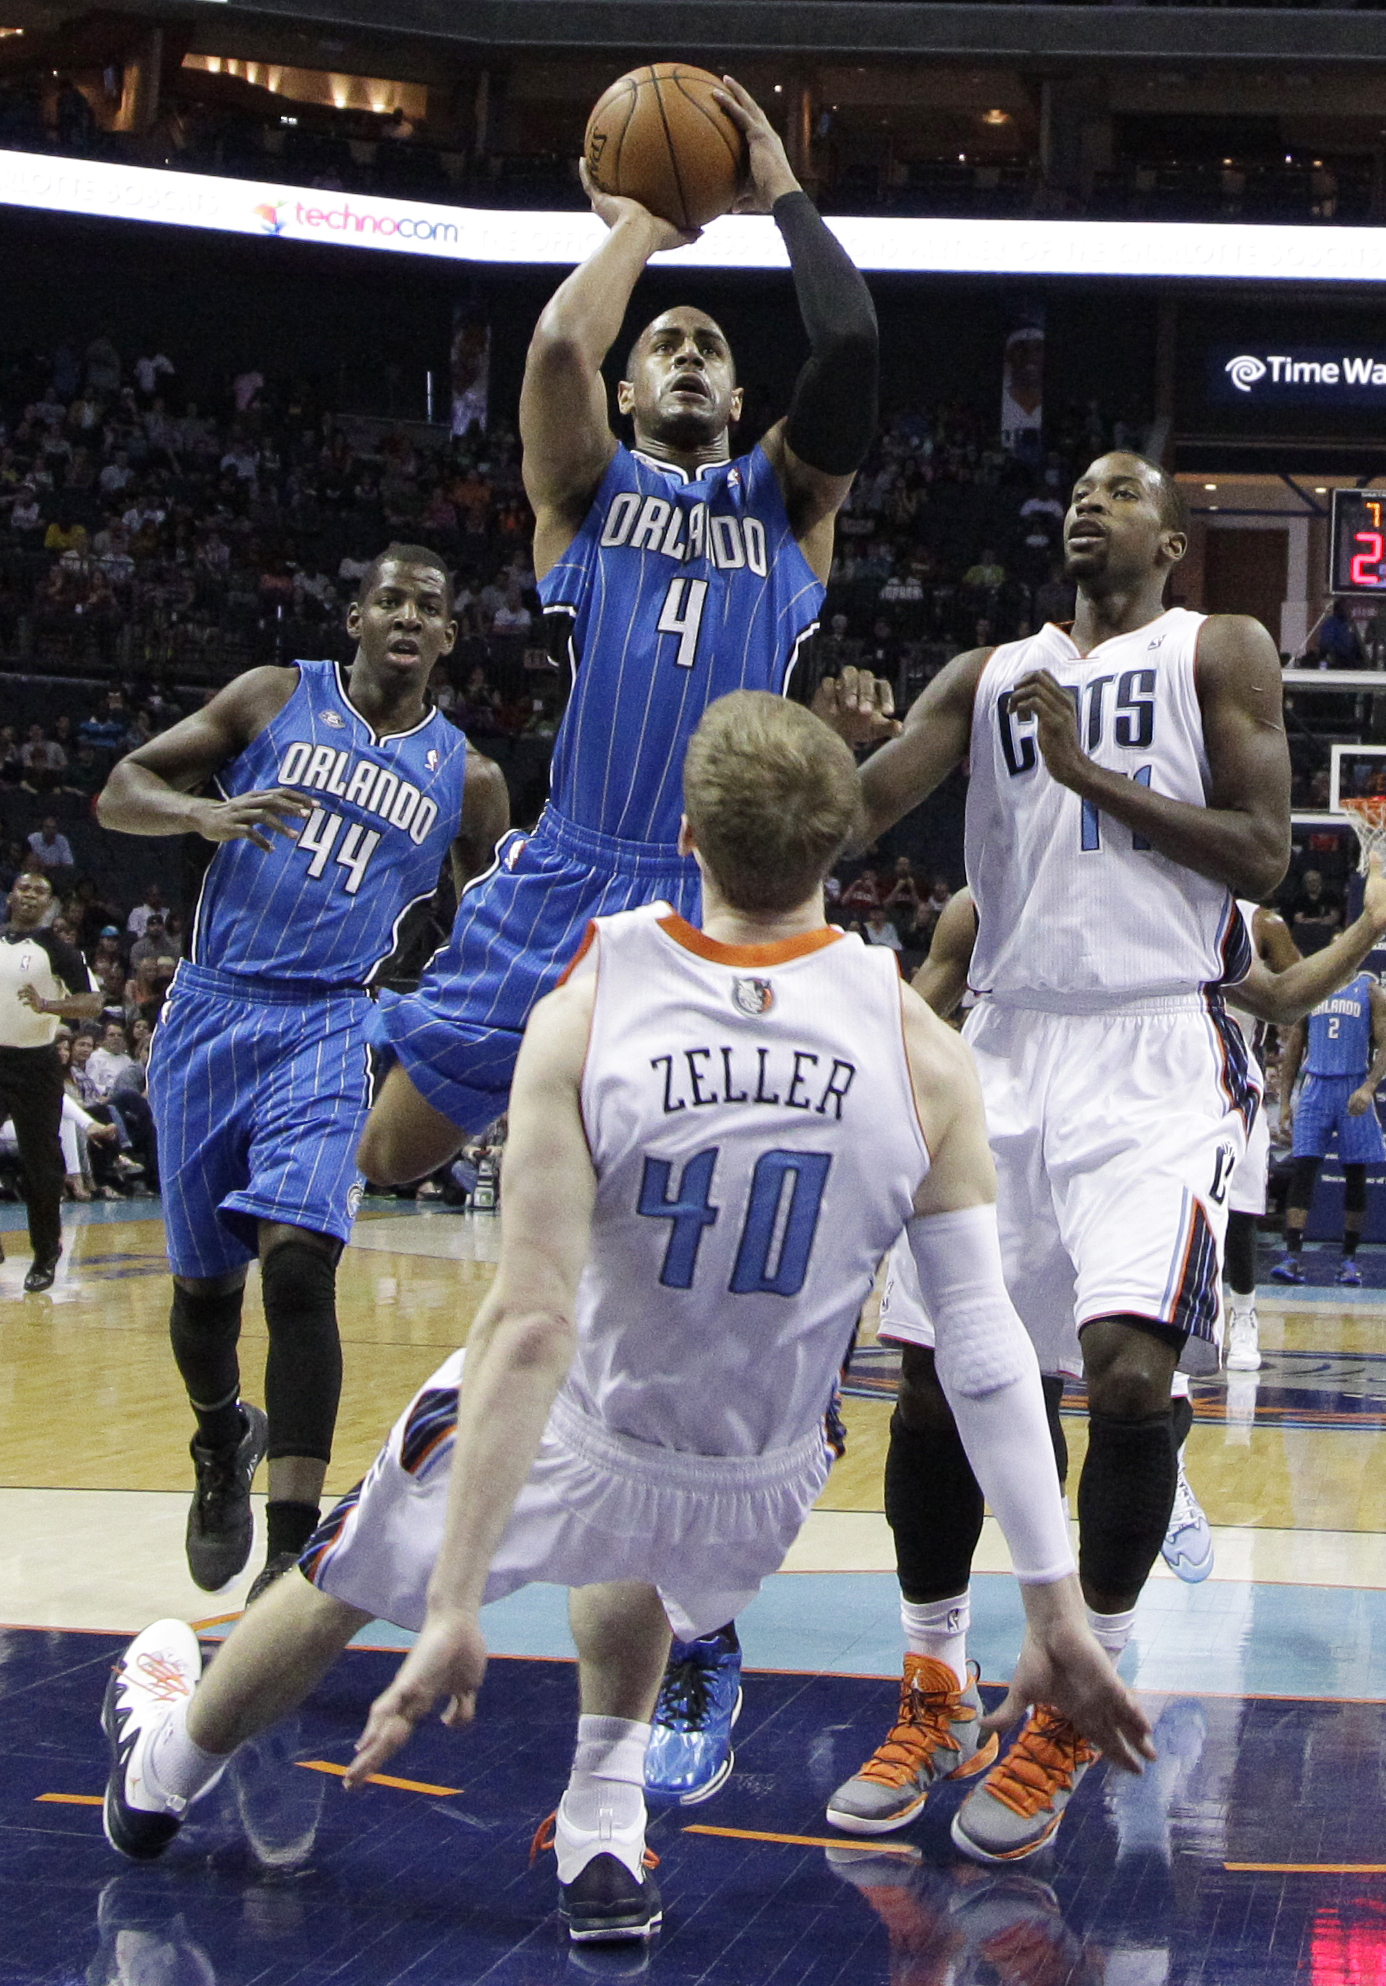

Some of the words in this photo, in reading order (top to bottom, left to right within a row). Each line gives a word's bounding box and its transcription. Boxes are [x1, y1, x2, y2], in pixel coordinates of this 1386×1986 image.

[296, 201, 458, 243] technocom
[1267, 355, 1340, 384] Time
[1343, 357, 1386, 386] Wa
[657, 577, 710, 669] 4
[277, 741, 439, 846] ORLANDO
[297, 808, 382, 896] 44
[1327, 1017, 1340, 1039] 2
[650, 1047, 857, 1121] ZELLER
[636, 1146, 833, 1297] 40
